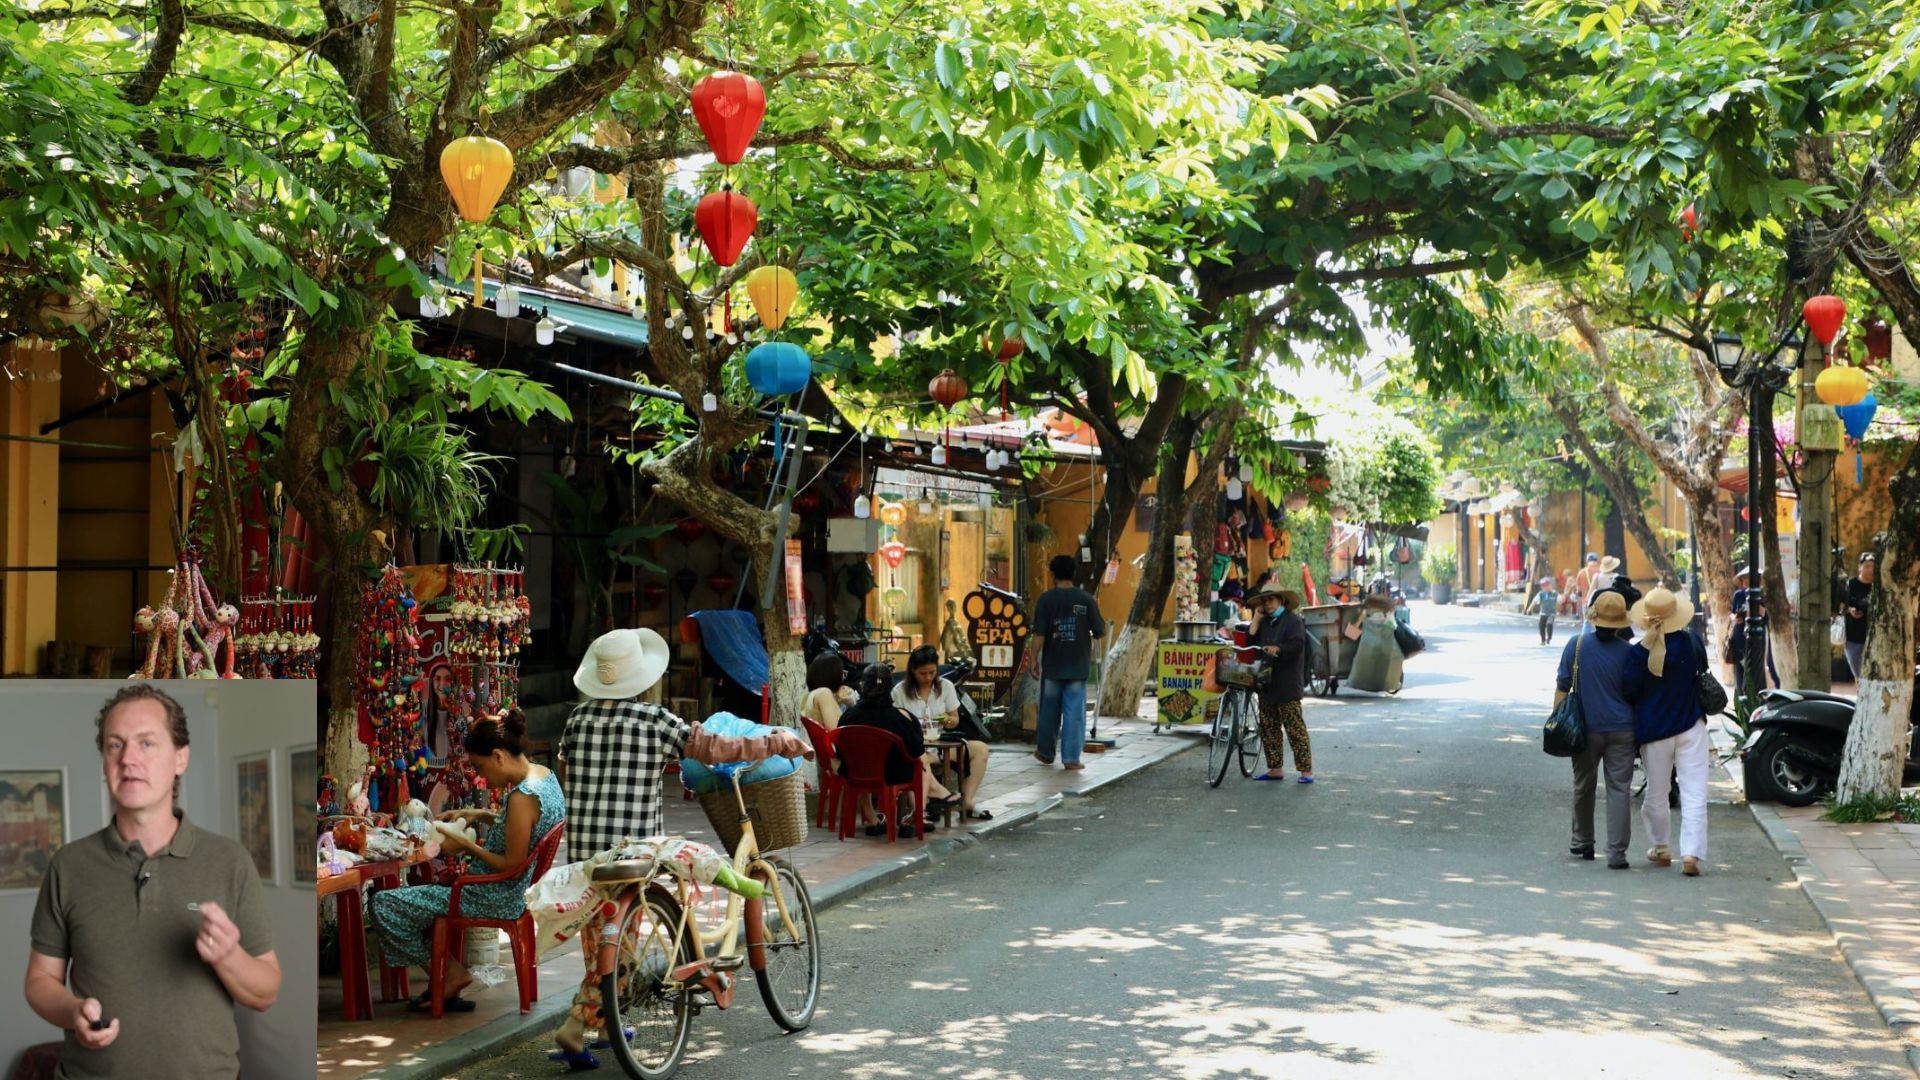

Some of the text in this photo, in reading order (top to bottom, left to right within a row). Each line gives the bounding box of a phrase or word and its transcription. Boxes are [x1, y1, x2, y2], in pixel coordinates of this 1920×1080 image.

[978, 619, 993, 628] Mr.
[976, 628, 1015, 644] SPA
[1164, 648, 1192, 666] BÁNH
[1162, 677, 1192, 689] BANANA
